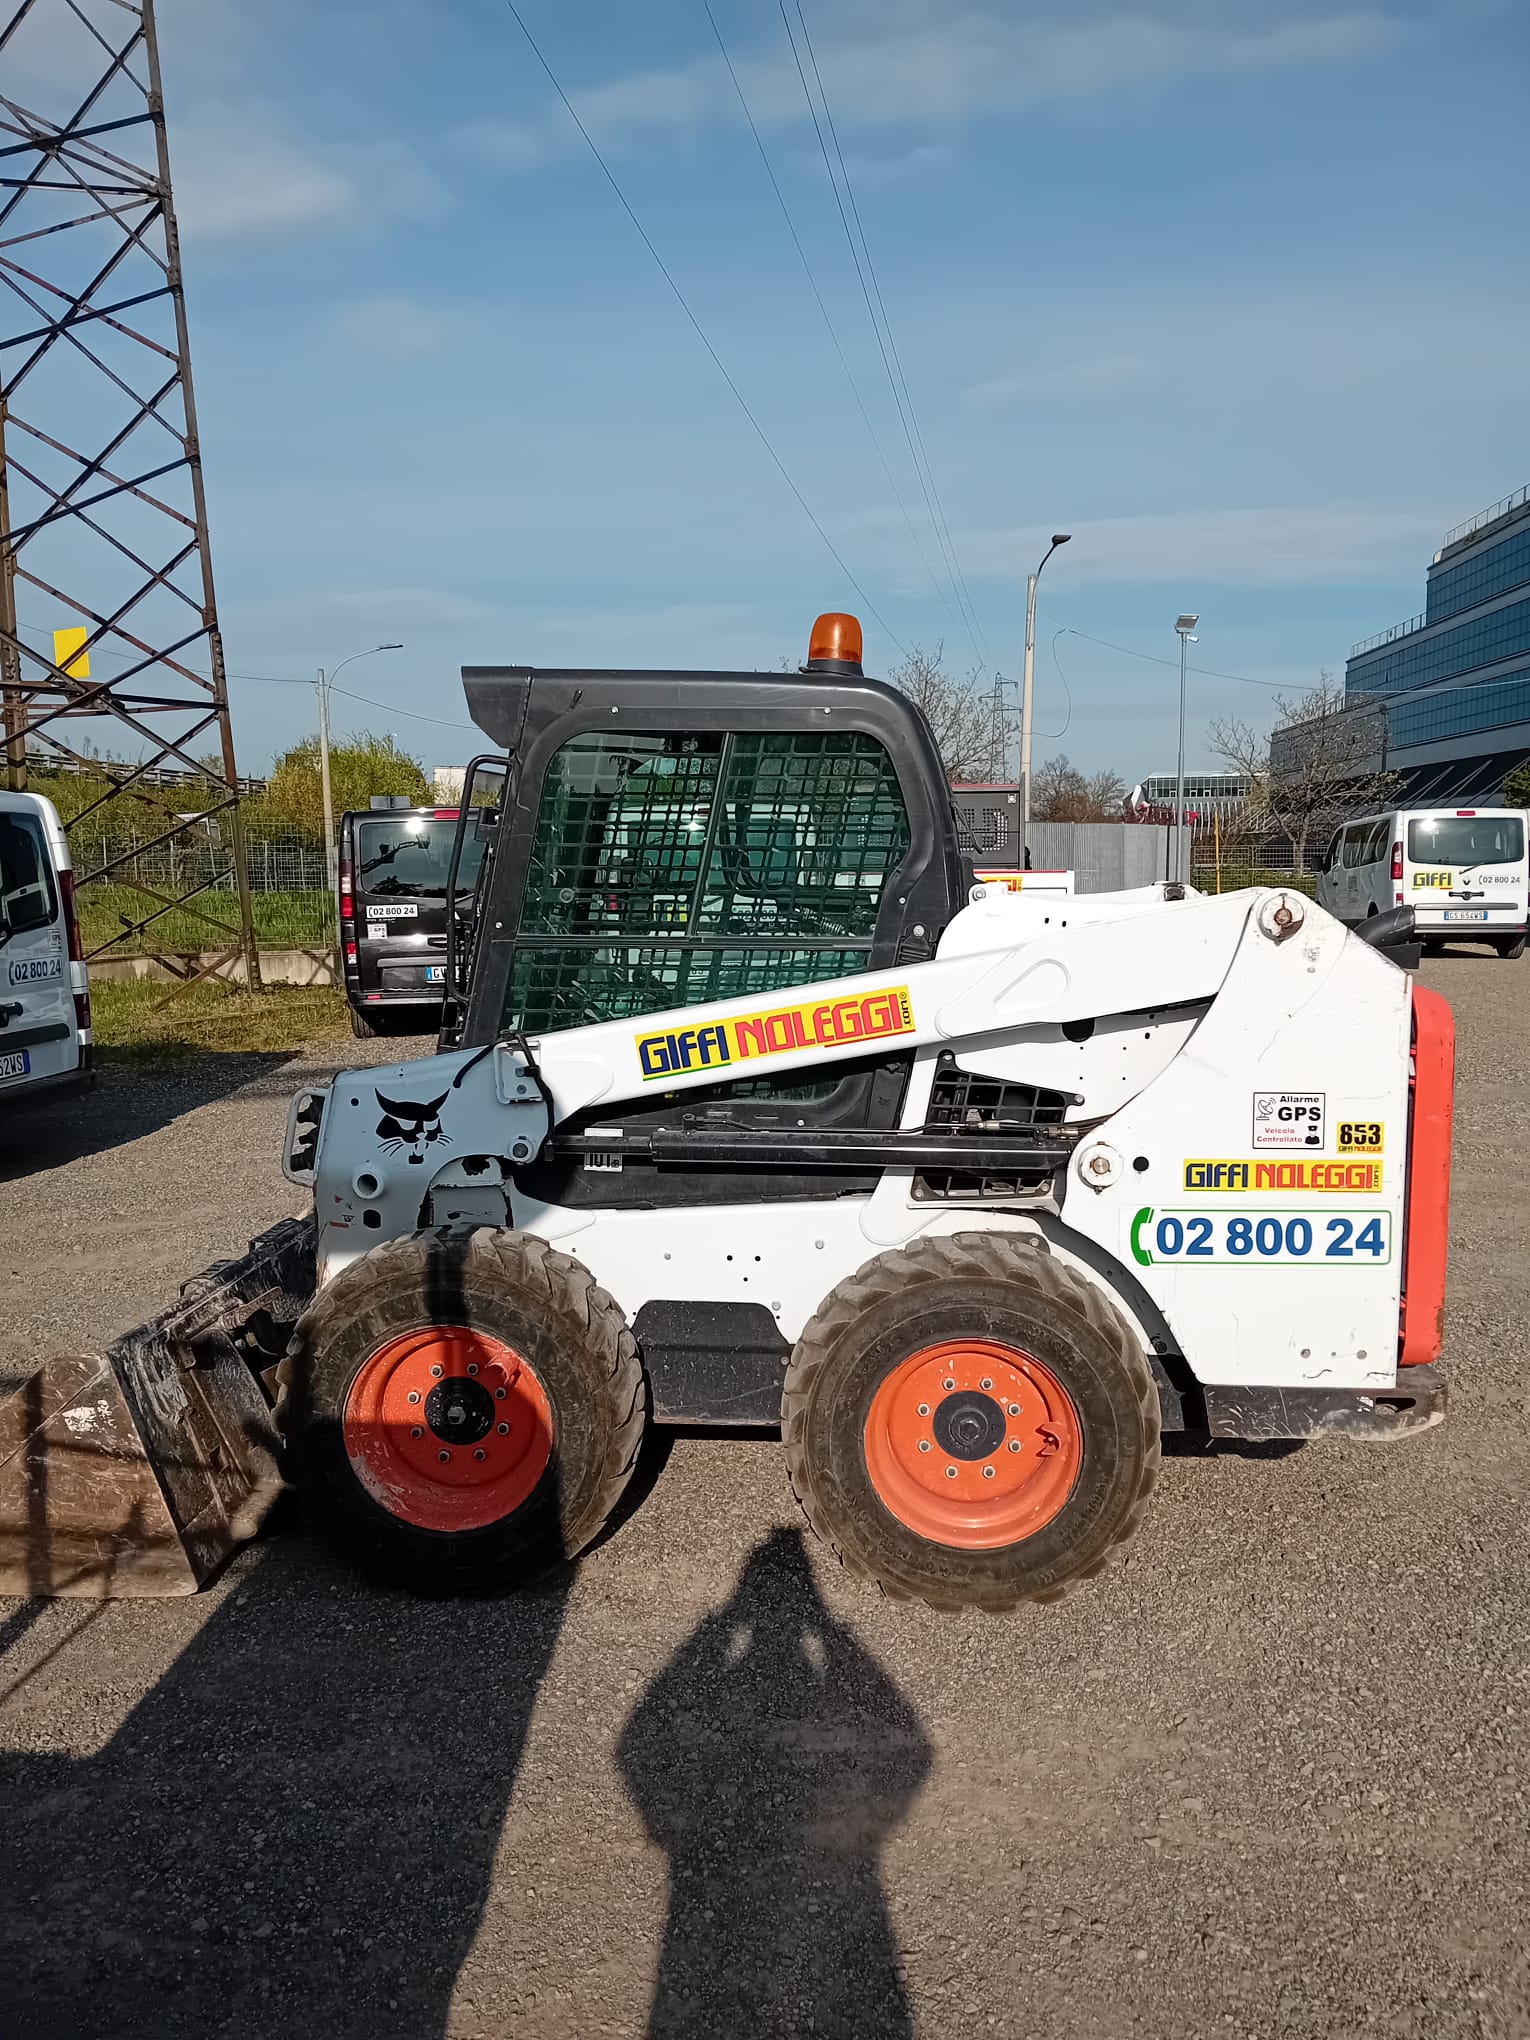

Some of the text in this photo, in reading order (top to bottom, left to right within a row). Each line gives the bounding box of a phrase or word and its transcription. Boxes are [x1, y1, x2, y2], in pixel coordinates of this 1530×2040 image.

[1413, 872, 1452, 887] GIFFI
[1510, 876, 1521, 884] 24
[373, 906, 415, 916] 02 800 24
[14, 958, 62, 981] 02 800 24
[638, 993, 903, 1076] GIFFI NOLEGGI
[1279, 1095, 1320, 1104] Allarme
[1277, 1106, 1322, 1121] GPS
[1256, 1135, 1303, 1143] Controllato
[1340, 1123, 1381, 1145] 853
[1185, 1163, 1374, 1189] GIFFI NOLEGGI
[1156, 1217, 1385, 1257] 02 800 24
